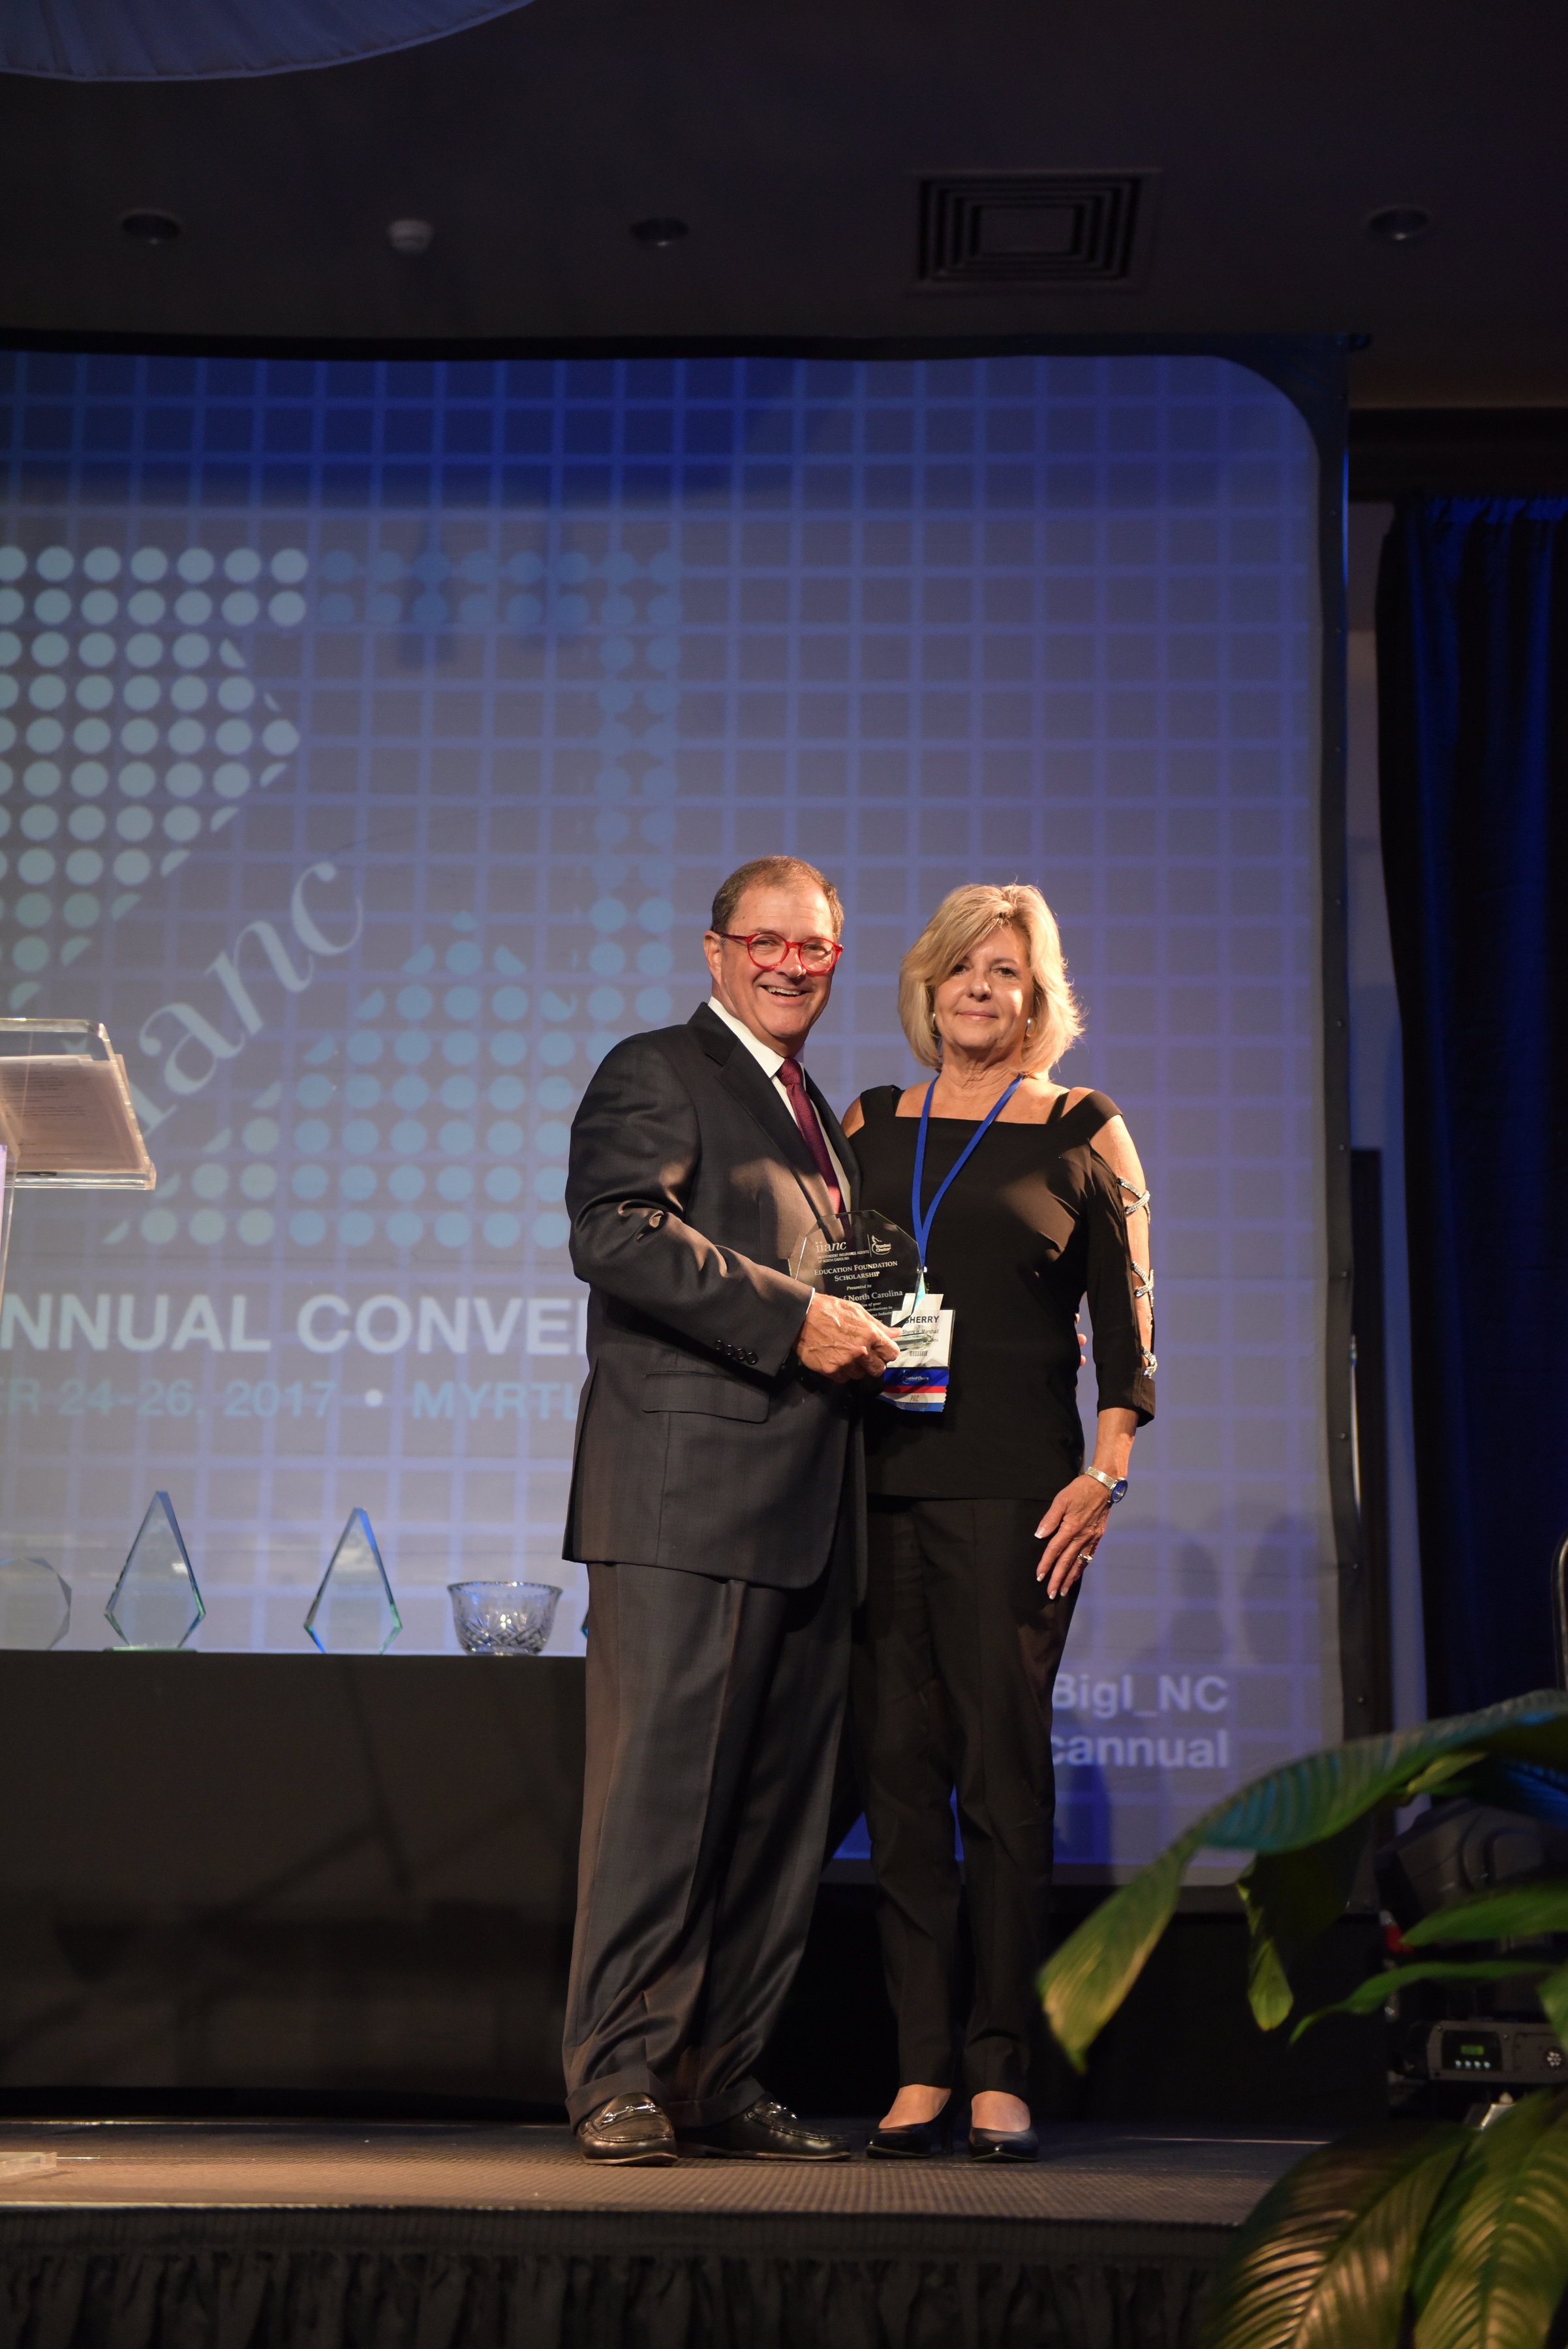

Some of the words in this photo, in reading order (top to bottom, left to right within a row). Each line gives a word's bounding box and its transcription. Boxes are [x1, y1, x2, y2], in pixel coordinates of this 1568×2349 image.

[814, 1266, 853, 1276] EDUCATION
[854, 1261, 898, 1271] FOUNDATION
[834, 1271, 880, 1282] SCHOLARSHIP
[848, 1293, 870, 1302] North
[871, 1290, 904, 1299] Carolina
[297, 1293, 588, 1355] CONVE
[59, 1378, 206, 1424] 24-26,
[223, 1379, 337, 1419] 2017
